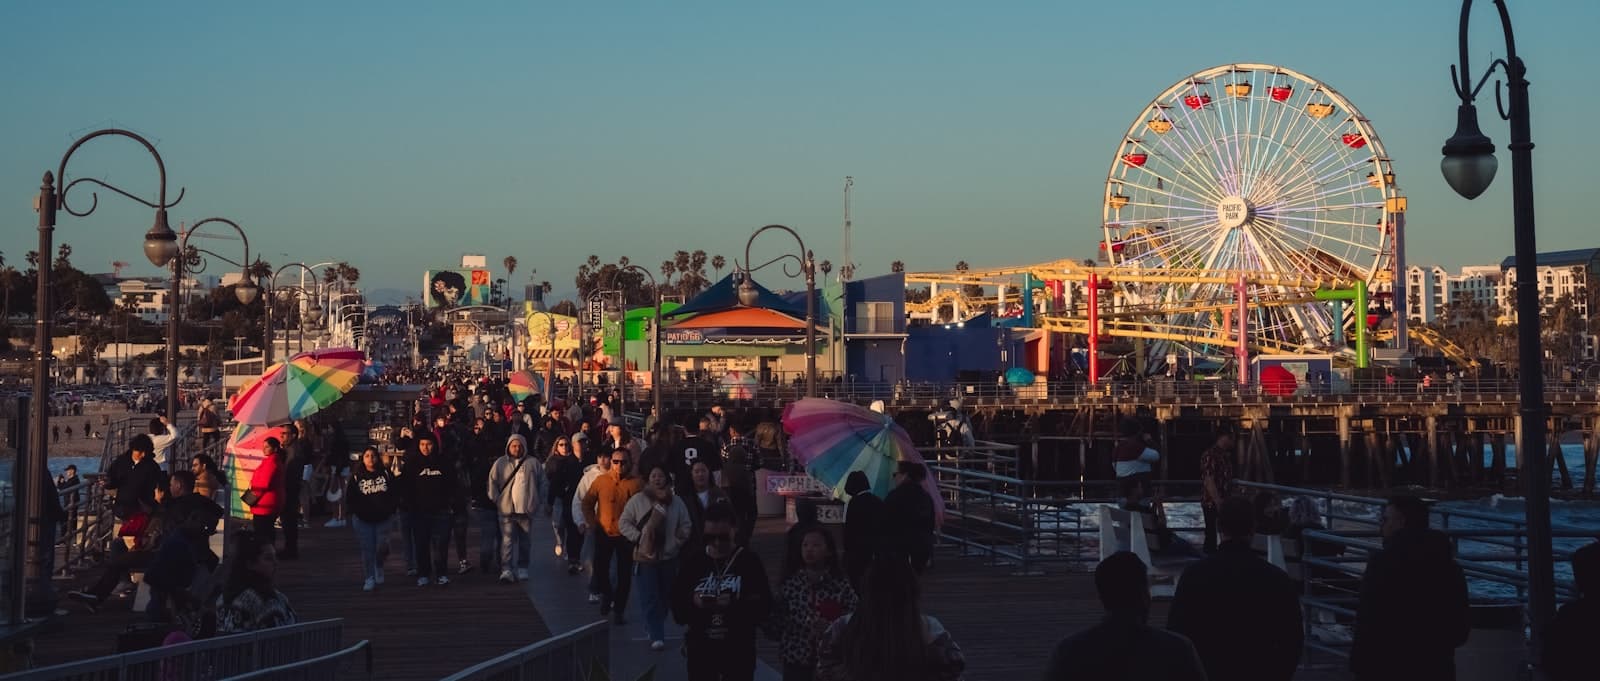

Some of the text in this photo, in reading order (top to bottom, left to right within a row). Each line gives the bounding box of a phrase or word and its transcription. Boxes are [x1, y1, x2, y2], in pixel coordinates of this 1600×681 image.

[1222, 203, 1242, 212] PACIFIC
[1225, 212, 1239, 220] PARK
[667, 332, 688, 341] PATIO
